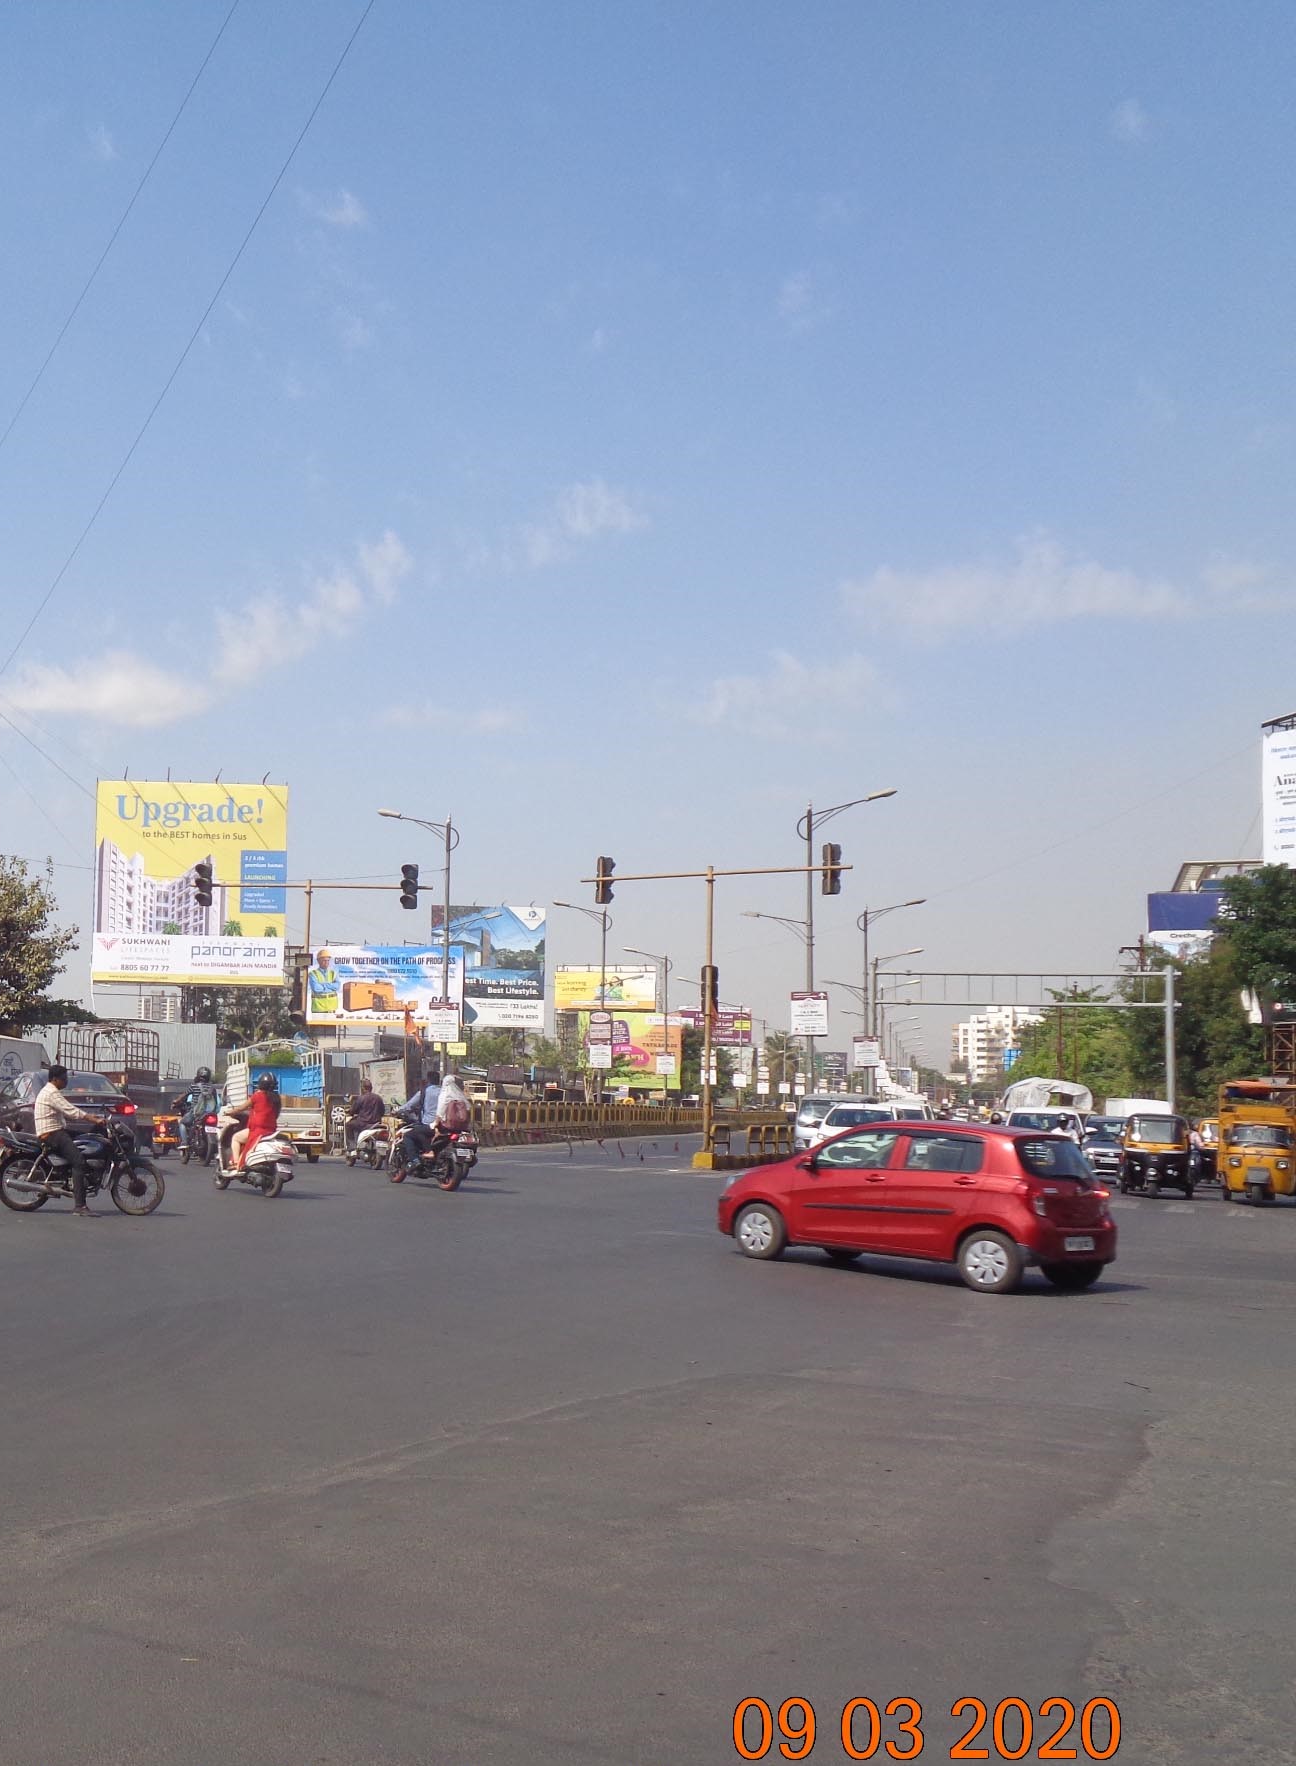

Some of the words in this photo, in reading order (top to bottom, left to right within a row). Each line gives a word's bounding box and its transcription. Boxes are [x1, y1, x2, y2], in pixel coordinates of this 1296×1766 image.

[115, 794, 264, 828] Upgrade!
[153, 831, 169, 839] the
[170, 831, 189, 839] BEST
[192, 832, 220, 840] homes
[222, 832, 231, 840] in
[233, 833, 247, 841] Sus
[191, 946, 277, 959] panorama
[334, 957, 351, 965] GROW
[352, 957, 380, 965] TOGETHER
[381, 957, 389, 965] ON
[390, 957, 401, 965] THE
[402, 957, 416, 965] PATH
[418, 957, 425, 965] OF
[505, 987, 539, 996] Lifestyle.
